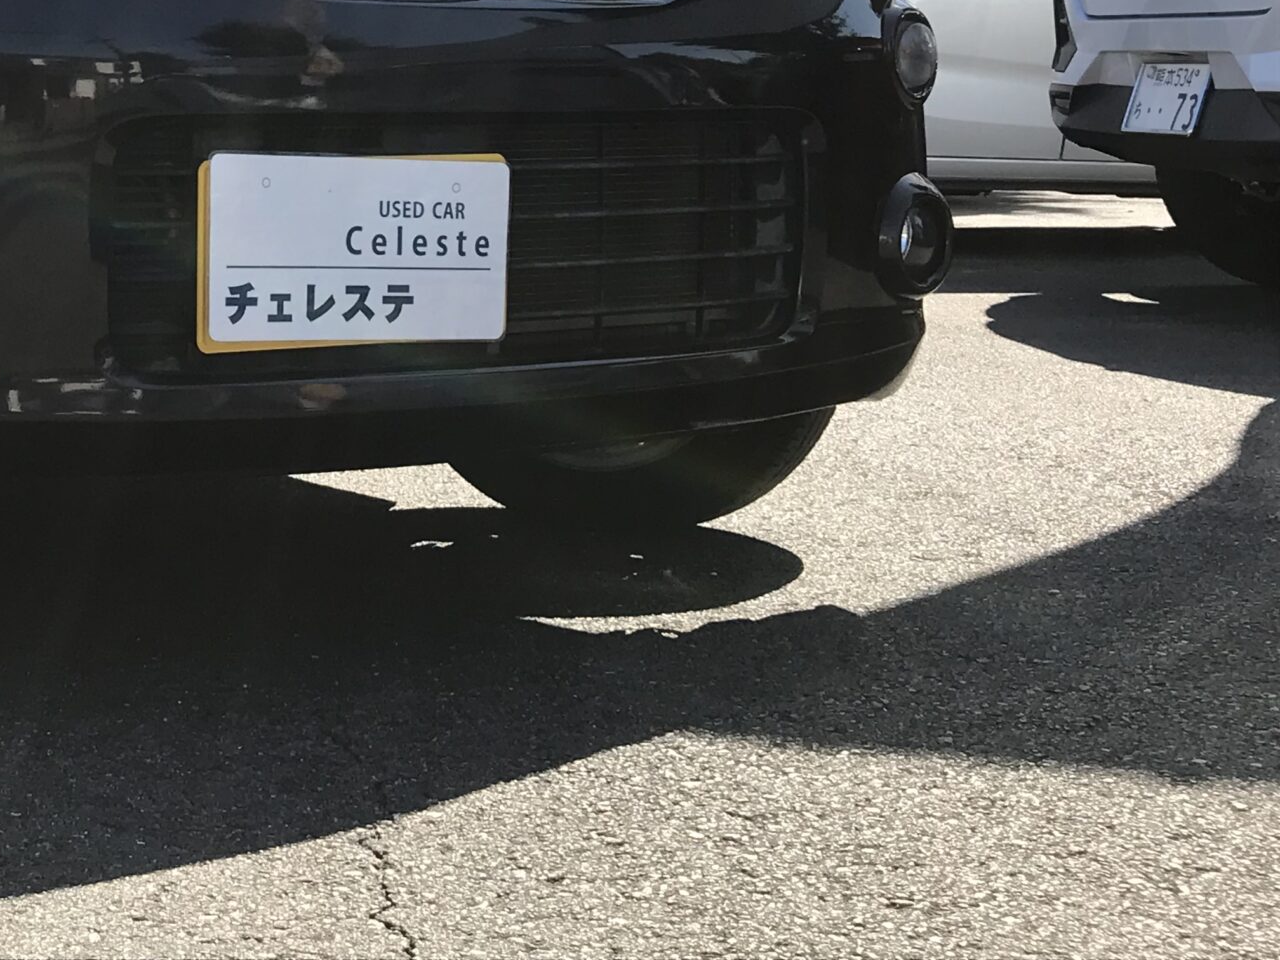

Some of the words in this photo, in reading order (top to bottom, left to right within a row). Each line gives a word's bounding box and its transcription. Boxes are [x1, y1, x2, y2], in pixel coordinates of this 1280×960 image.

[379, 200, 424, 218] USED
[432, 202, 465, 219] CAR
[345, 226, 490, 256] Celeste
[225, 282, 414, 324] チェレステ
